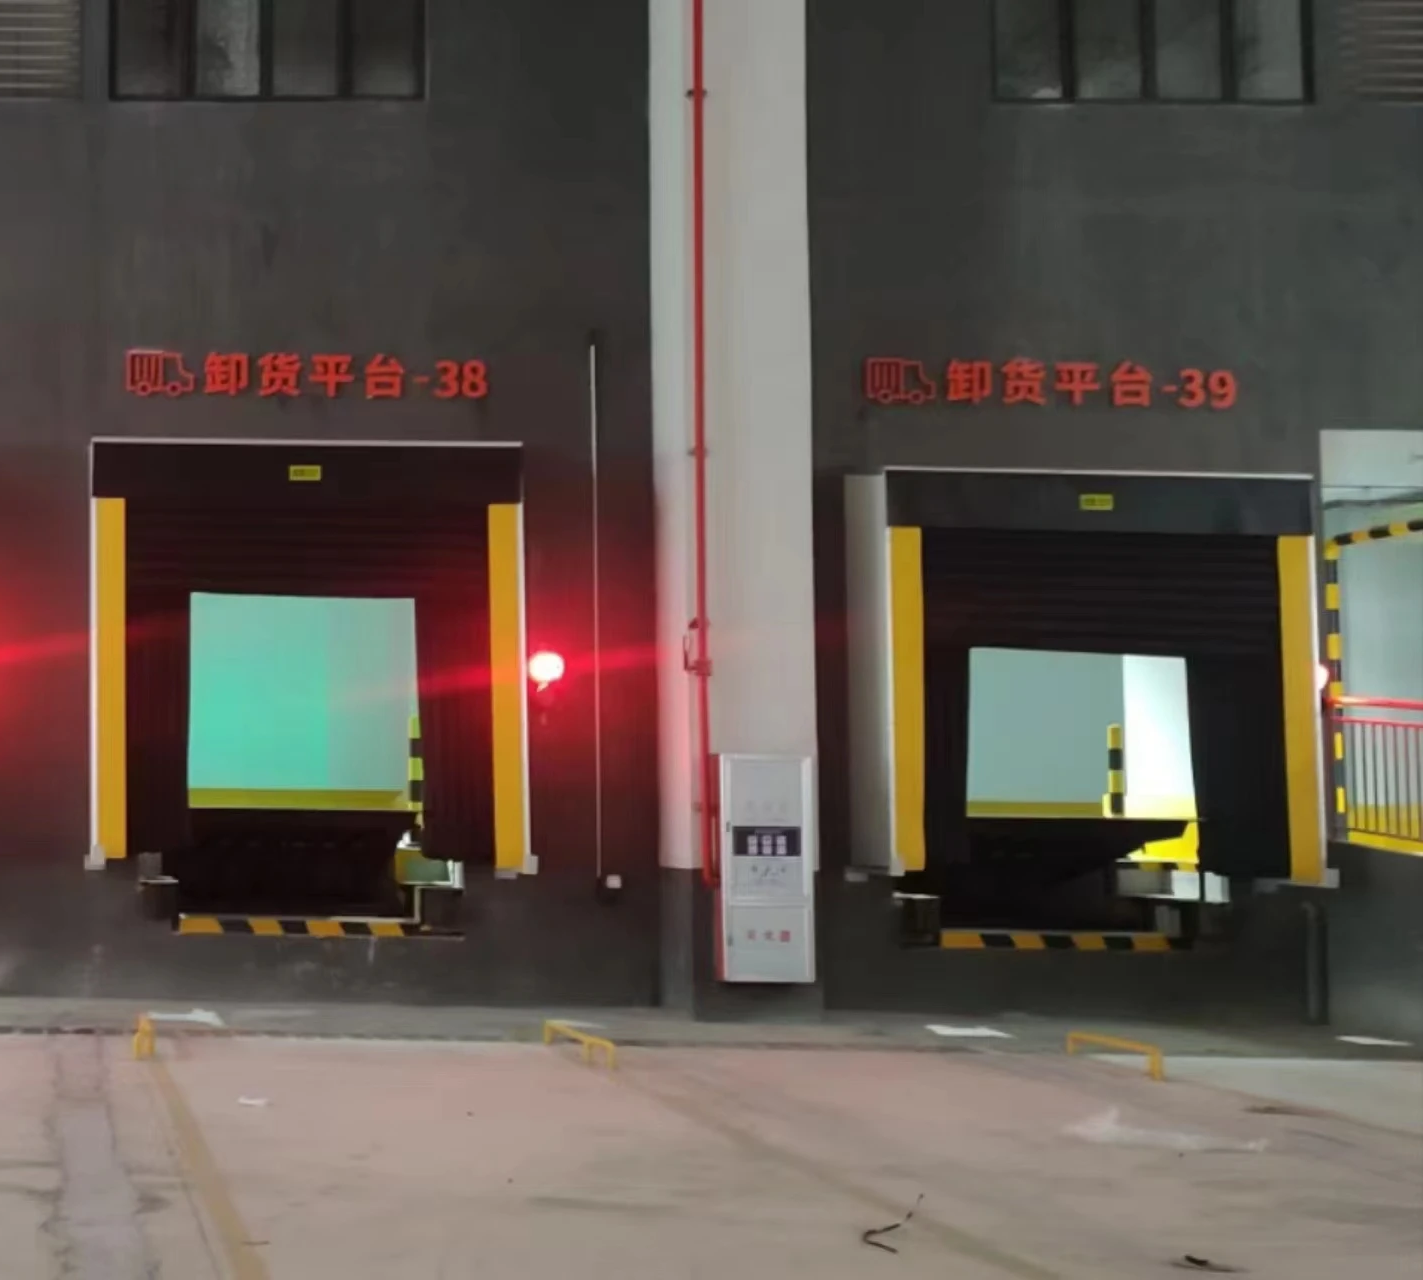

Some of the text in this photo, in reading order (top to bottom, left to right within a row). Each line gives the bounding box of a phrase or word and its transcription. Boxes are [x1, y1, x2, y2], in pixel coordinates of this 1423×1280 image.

[203, 352, 488, 399] 卸货平台-38
[946, 359, 1238, 409] 卸货平台-39
